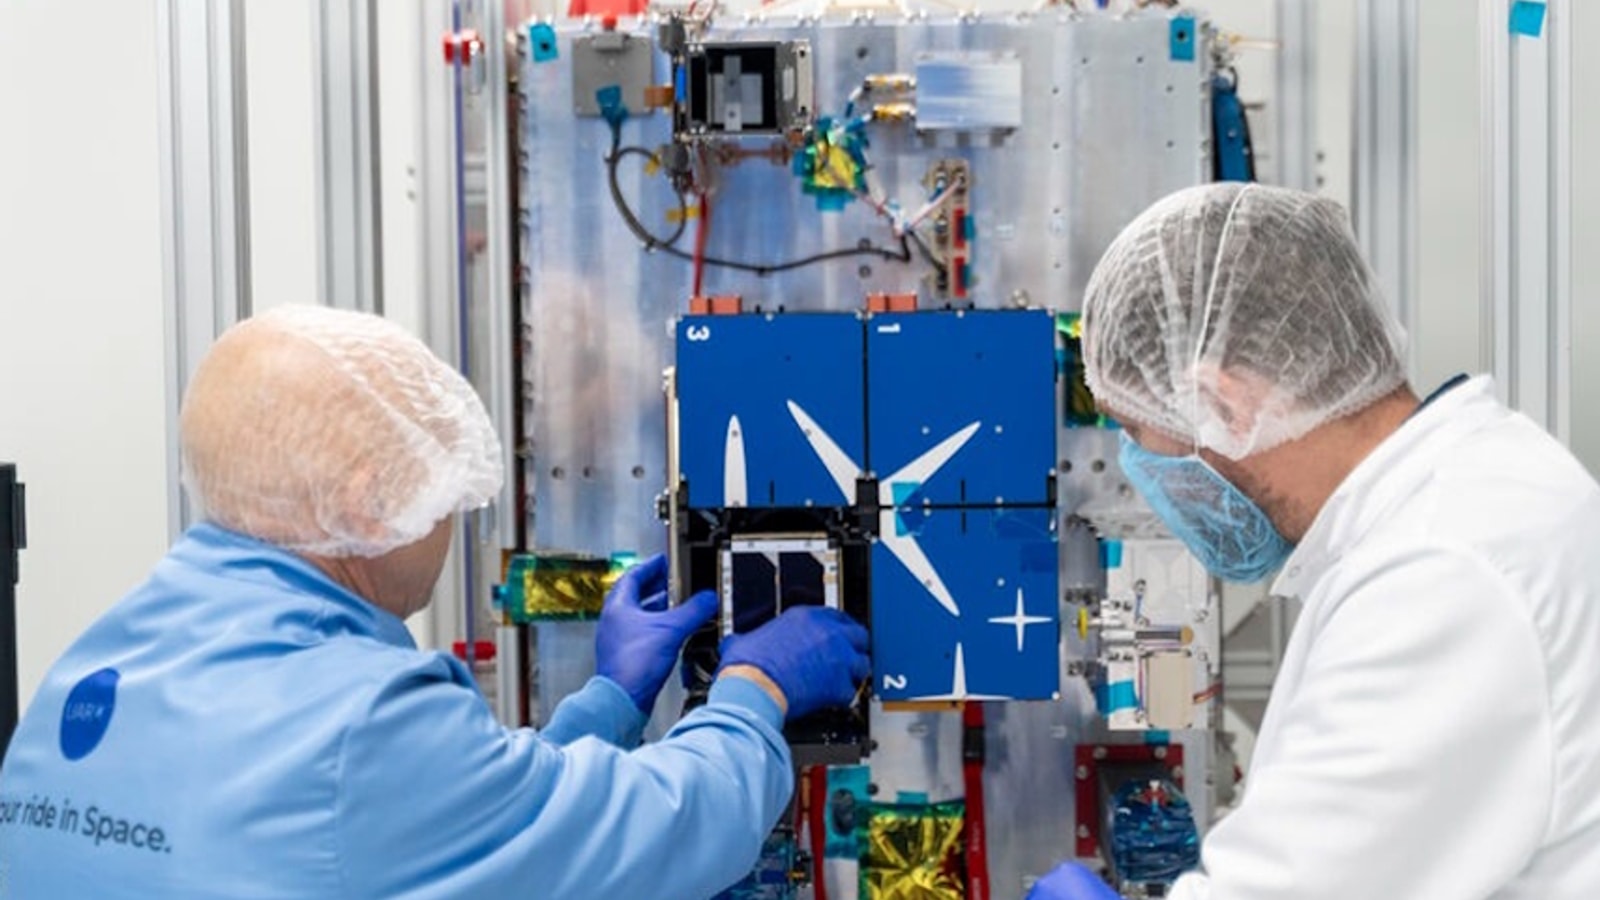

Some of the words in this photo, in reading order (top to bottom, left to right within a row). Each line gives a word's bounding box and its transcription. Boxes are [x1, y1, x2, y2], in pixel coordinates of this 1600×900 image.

[687, 325, 710, 341] 3
[878, 323, 900, 333] 1
[884, 674, 907, 690] 2
[21, 794, 57, 828] ride
[59, 798, 79, 834] in
[82, 805, 172, 853] Space.
